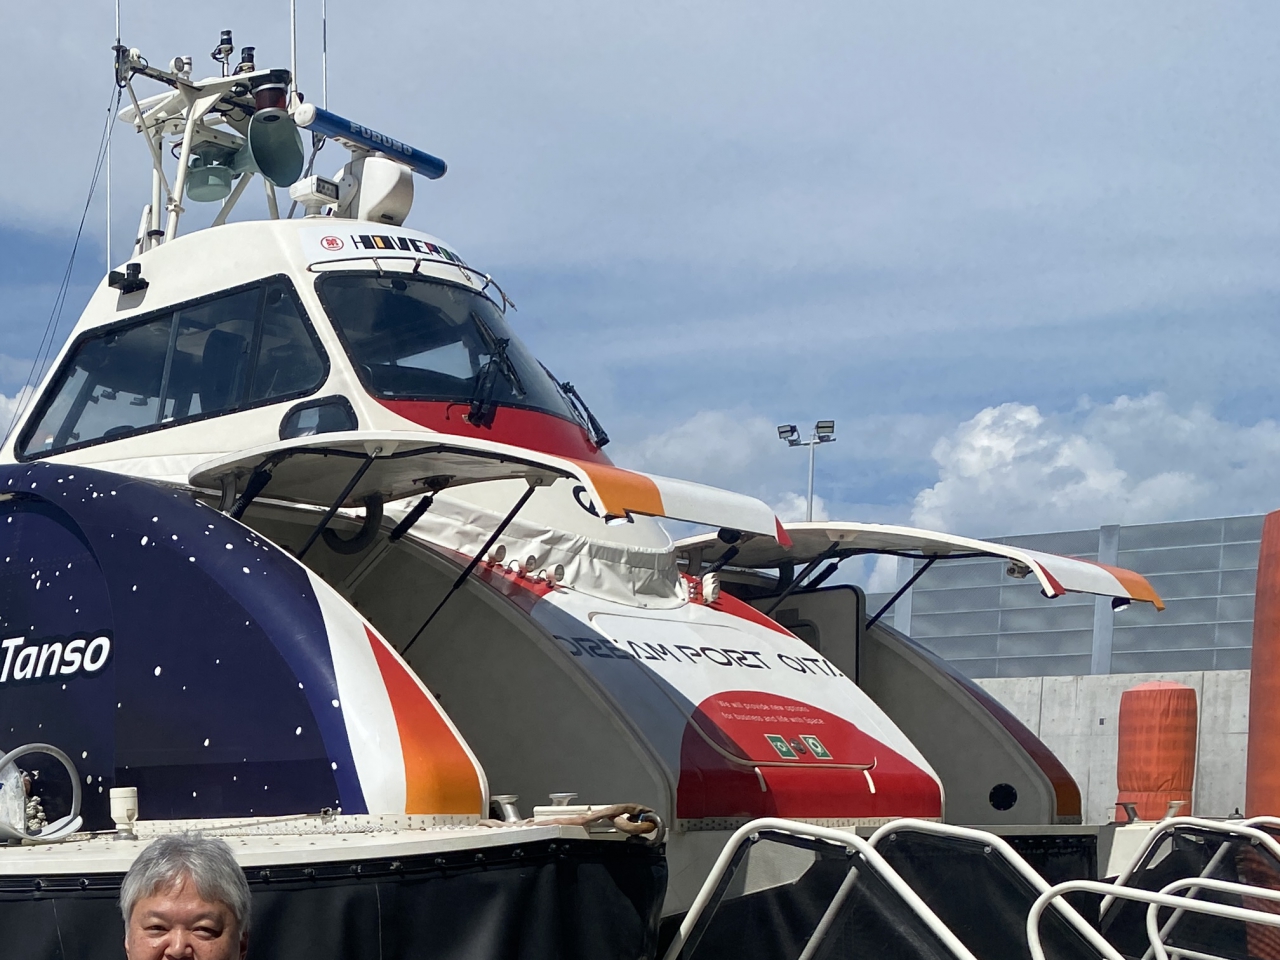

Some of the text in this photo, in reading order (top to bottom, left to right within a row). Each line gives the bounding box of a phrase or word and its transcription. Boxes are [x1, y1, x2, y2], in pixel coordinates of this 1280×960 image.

[350, 121, 413, 156] FURUNO
[0, 636, 111, 682] Tanso
[552, 635, 682, 663] DREAM
[673, 644, 771, 671] PORT
[733, 713, 764, 722] business
[764, 715, 778, 723] and
[790, 716, 804, 724] with
[743, 703, 770, 711] provide
